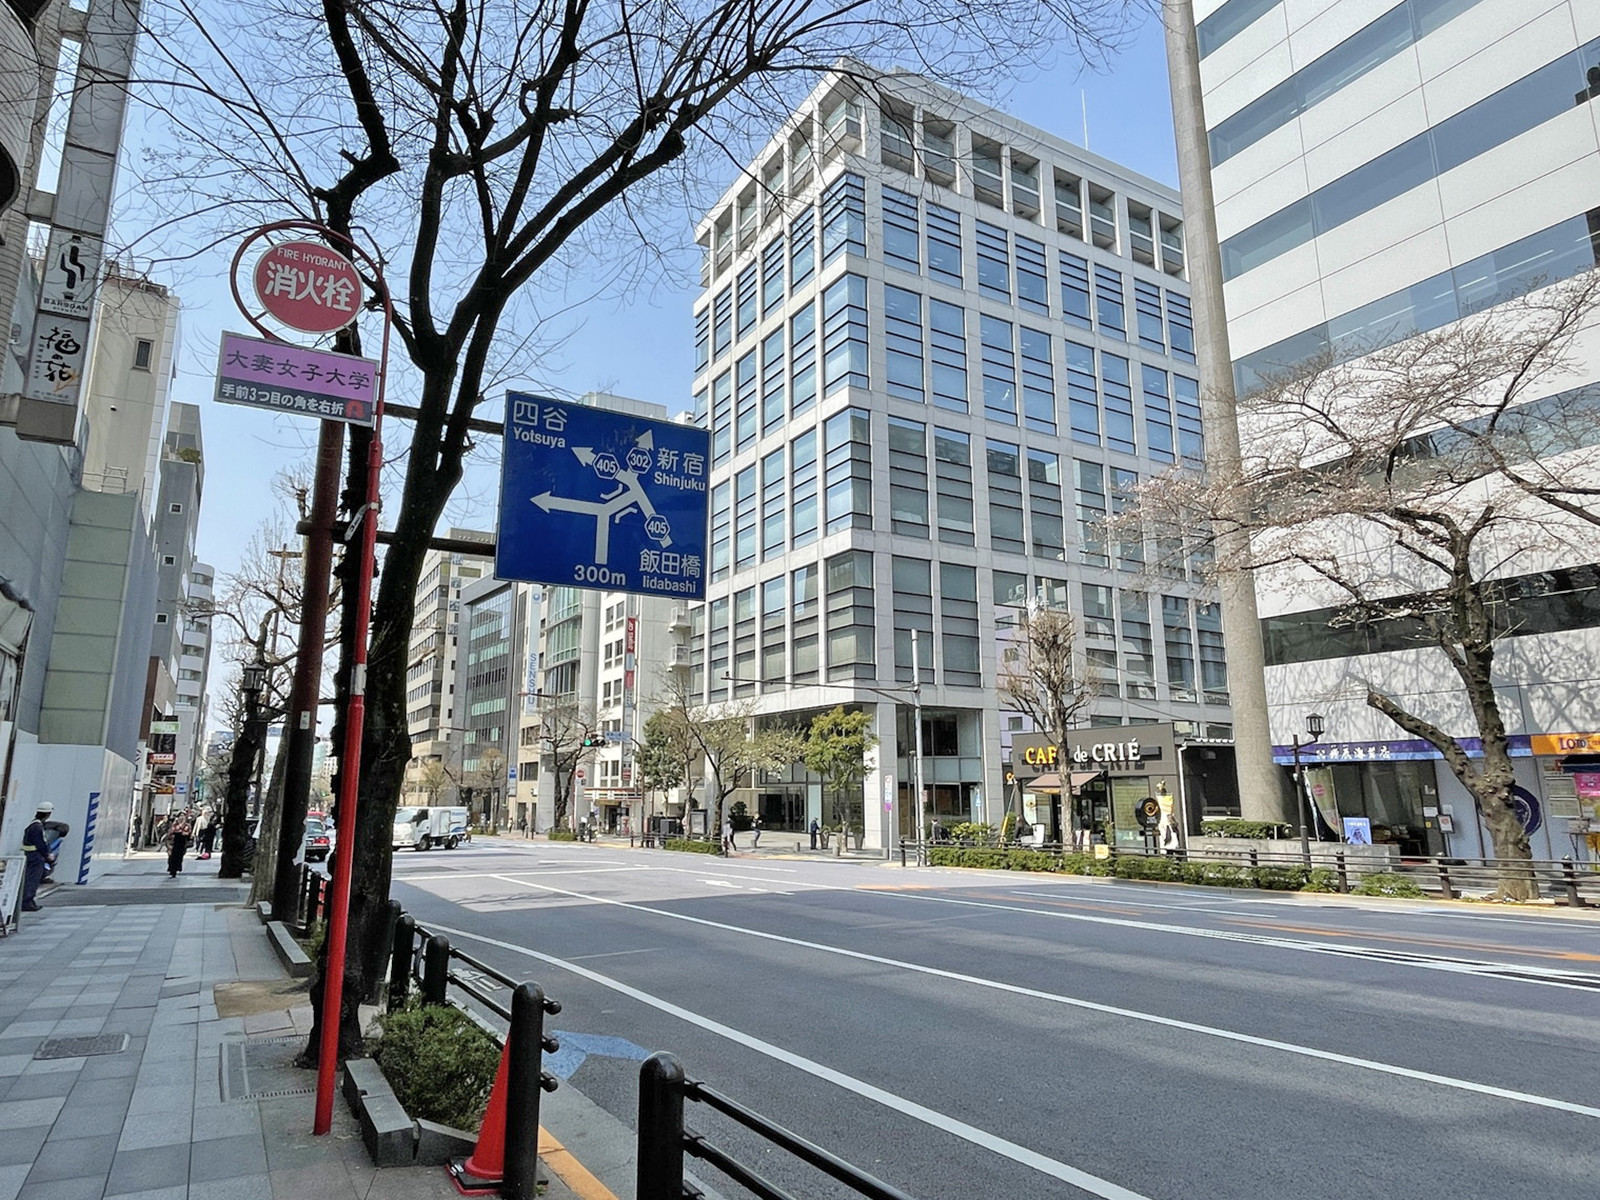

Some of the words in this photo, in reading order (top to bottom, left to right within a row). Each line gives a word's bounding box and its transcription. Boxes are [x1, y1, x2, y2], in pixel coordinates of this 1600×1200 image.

[277, 247, 299, 261] FIRE
[302, 252, 348, 271] HYDRANT
[264, 261, 355, 312] 消火栓
[226, 350, 370, 390] 大妻女子大学
[221, 383, 345, 416] 手前3つ目の角を右折
[513, 400, 568, 432] 四谷
[513, 426, 566, 449] Yotsuya
[596, 458, 616, 474] 405
[629, 452, 649, 468] 302
[656, 446, 705, 477] 新宿
[654, 471, 706, 492] Shinjuku
[647, 520, 667, 535] 405
[573, 564, 626, 586] 300m
[639, 548, 701, 579] 飯田橋
[642, 575, 696, 594] Iidabashi
[528, 653, 537, 705] SENSHU
[1025, 745, 1058, 765] CAF
[1073, 744, 1089, 763] de
[1091, 737, 1141, 762] CRIÉ
